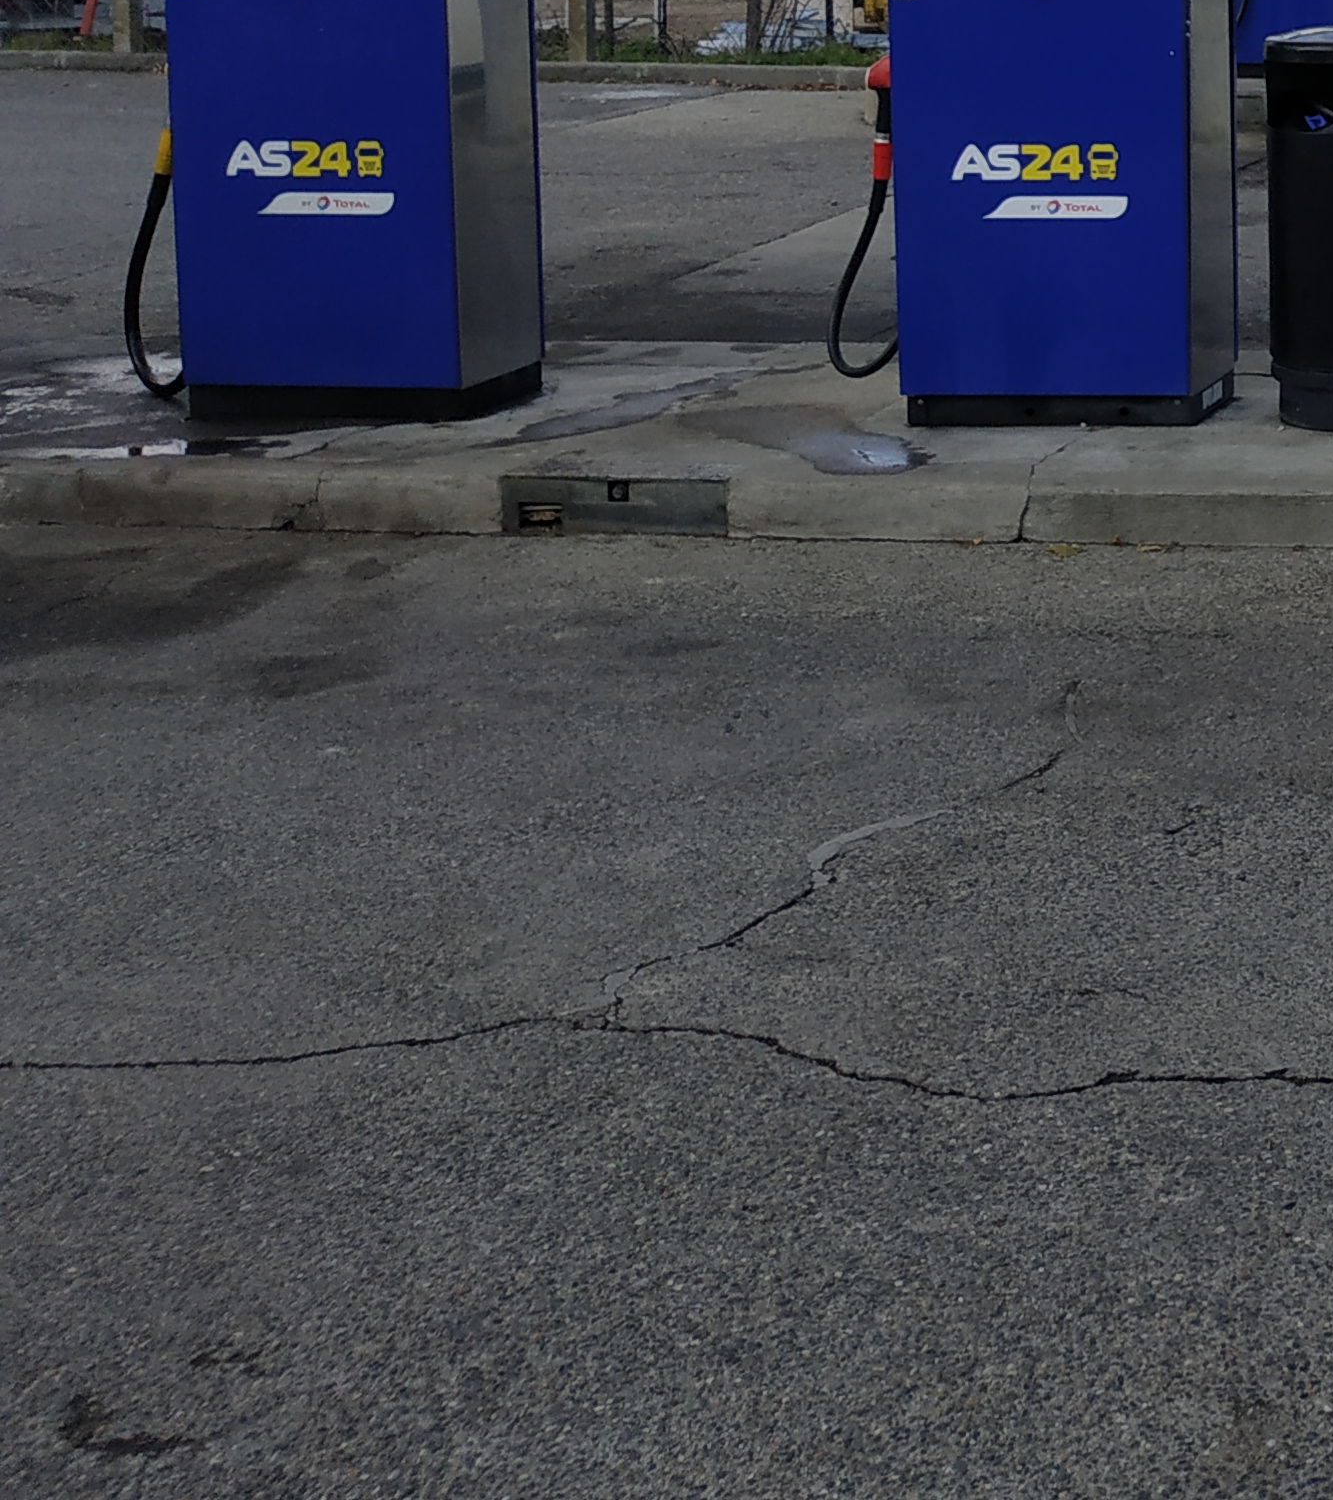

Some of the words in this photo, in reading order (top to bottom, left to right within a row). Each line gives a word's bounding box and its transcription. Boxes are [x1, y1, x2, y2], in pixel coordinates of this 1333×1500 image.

[226, 140, 352, 178] AS24
[951, 143, 1084, 181] AS24
[333, 199, 371, 209] TOTAL
[1064, 202, 1104, 212] TOTAL
